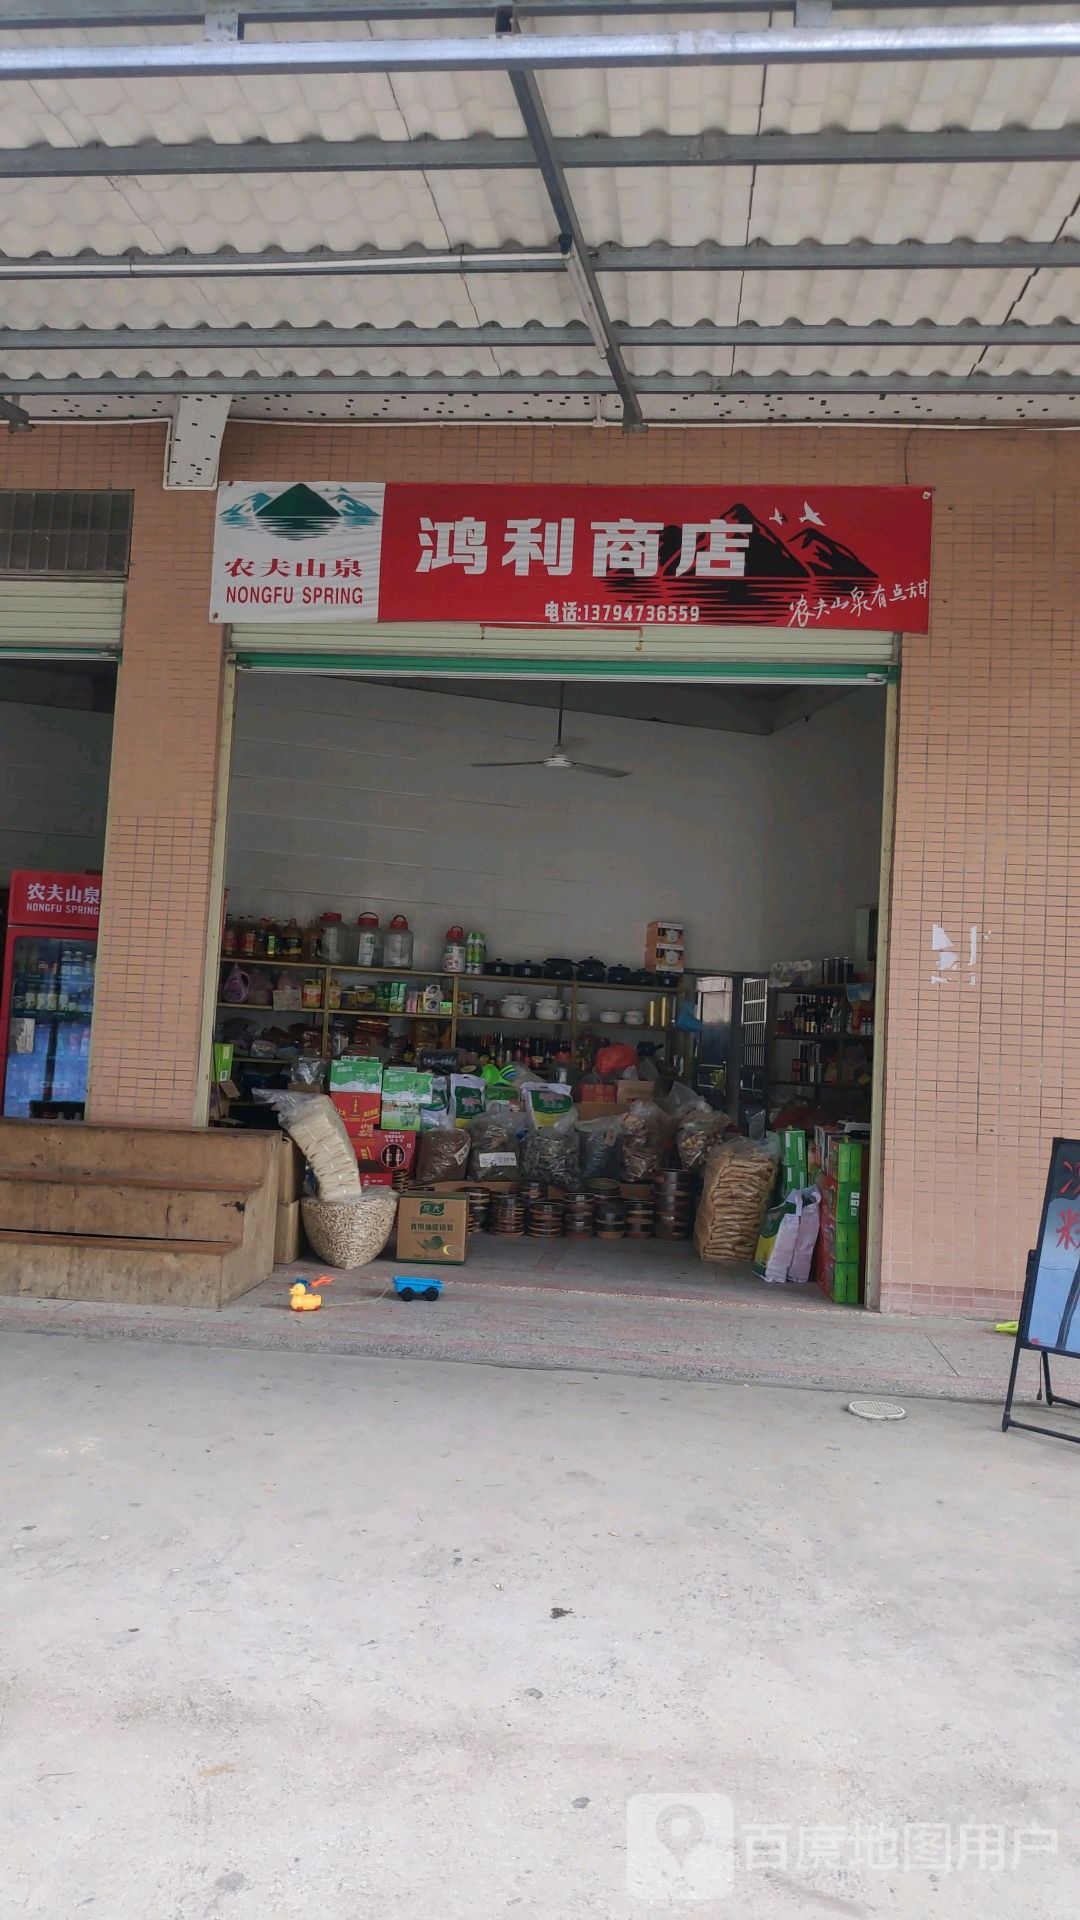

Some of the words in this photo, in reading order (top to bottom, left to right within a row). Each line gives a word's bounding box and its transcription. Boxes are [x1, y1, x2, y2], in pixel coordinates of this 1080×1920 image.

[415, 517, 753, 578] 鸿利商店
[224, 557, 363, 579] 农夫山泉
[226, 586, 294, 604] NONGFU
[302, 586, 363, 605] SPRING
[787, 578, 929, 628] 农夫山泉有点甜
[27, 883, 100, 904] 农夫山泉
[26, 902, 62, 913] NONGFU
[66, 904, 100, 916] SPRING
